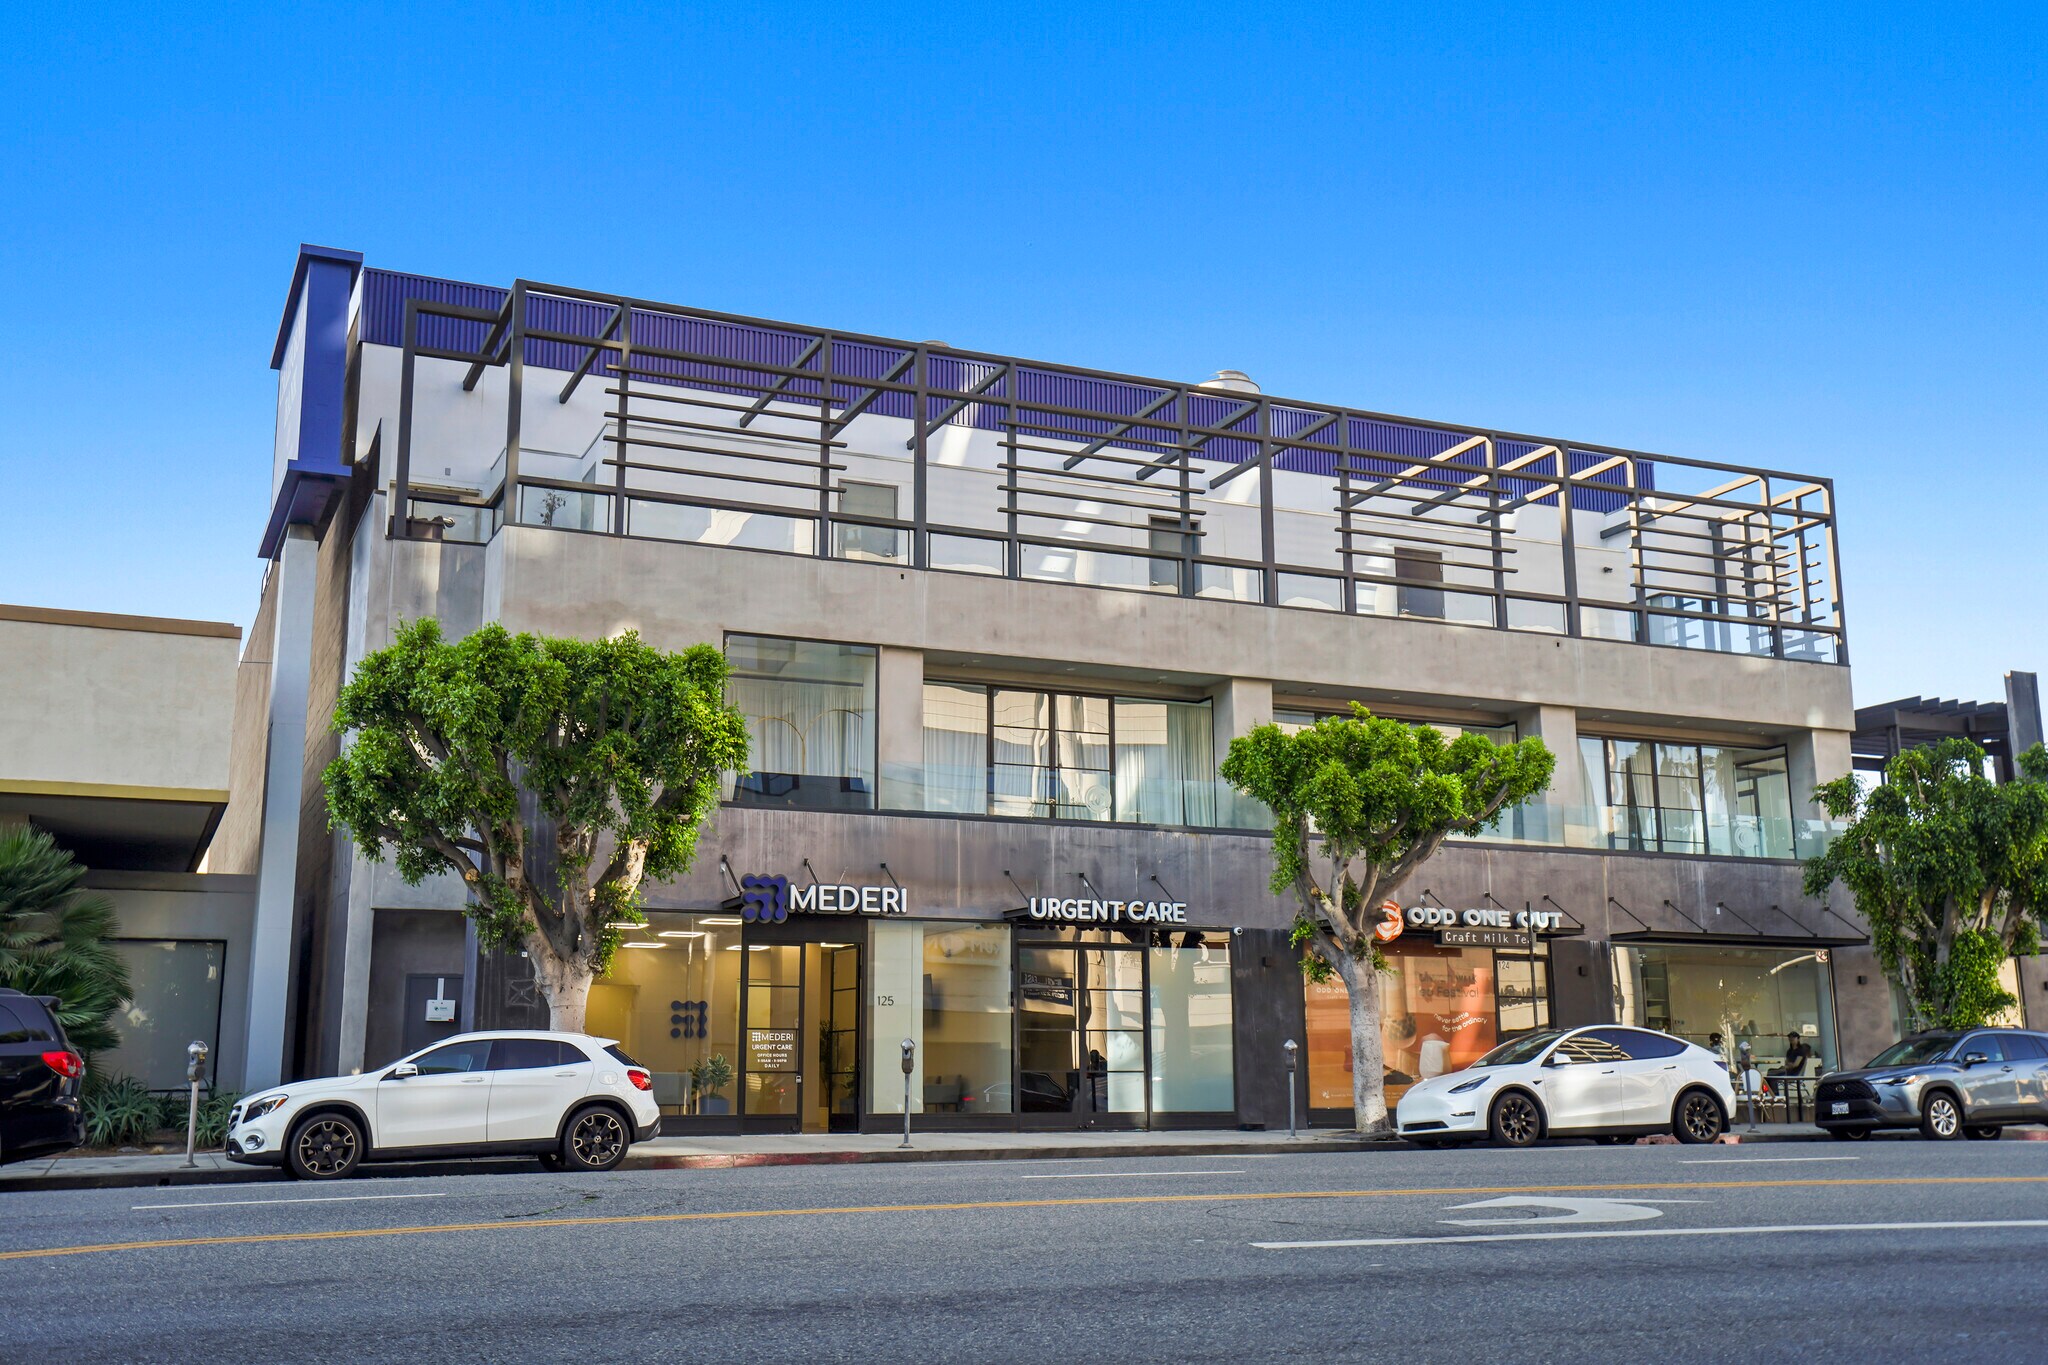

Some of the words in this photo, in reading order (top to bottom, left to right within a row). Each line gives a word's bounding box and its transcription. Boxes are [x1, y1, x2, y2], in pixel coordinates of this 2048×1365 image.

[789, 883, 908, 914] MEDERI
[1029, 896, 1124, 922] URGENT
[1126, 900, 1188, 924] CARE
[1407, 906, 1457, 927] ODD
[1463, 909, 1512, 928] ONE
[1516, 911, 1563, 930] OUT
[1445, 931, 1477, 943] Craft
[1483, 933, 1509, 944] Milk
[1498, 961, 1510, 970] 124
[878, 995, 894, 1006] 125
[1434, 1013, 1451, 1024] never
[1452, 1011, 1470, 1024] settle
[1452, 1024, 1462, 1032] the
[1462, 1017, 1488, 1028] ordinary
